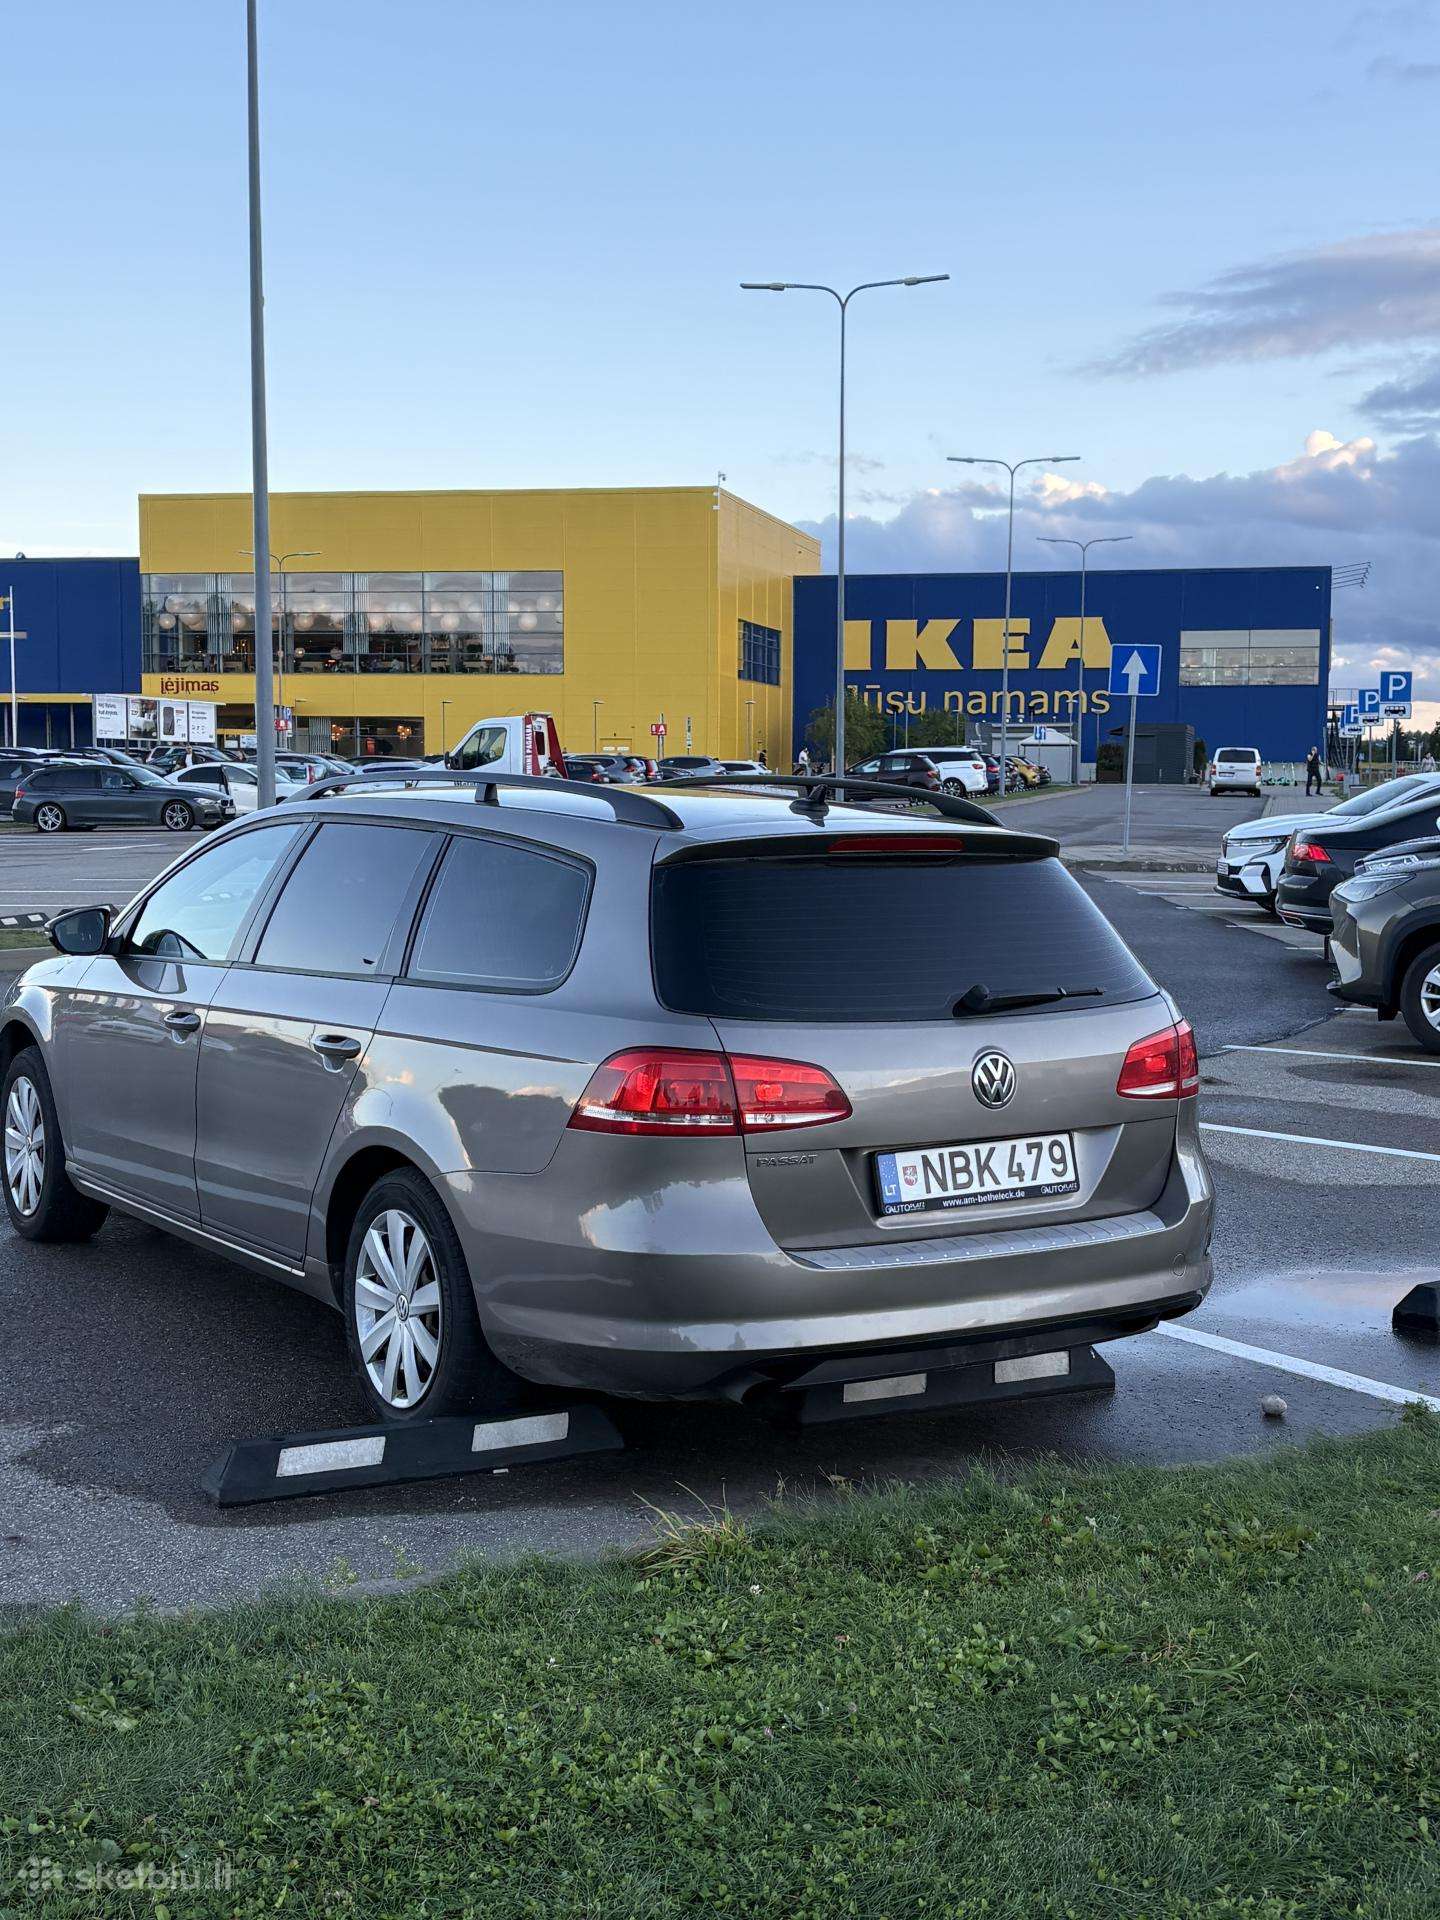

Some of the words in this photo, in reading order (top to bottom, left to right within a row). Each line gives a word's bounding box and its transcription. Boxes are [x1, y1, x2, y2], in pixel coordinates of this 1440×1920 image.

[843, 616, 1113, 671] IKEA
[1389, 674, 1407, 699] P
[943, 689, 1112, 715] namams
[1364, 691, 1379, 712] P
[756, 1154, 818, 1168] PASSAT
[920, 1146, 1002, 1195] NBK
[1007, 1138, 1068, 1183] 479
[884, 1184, 897, 1196] LT
